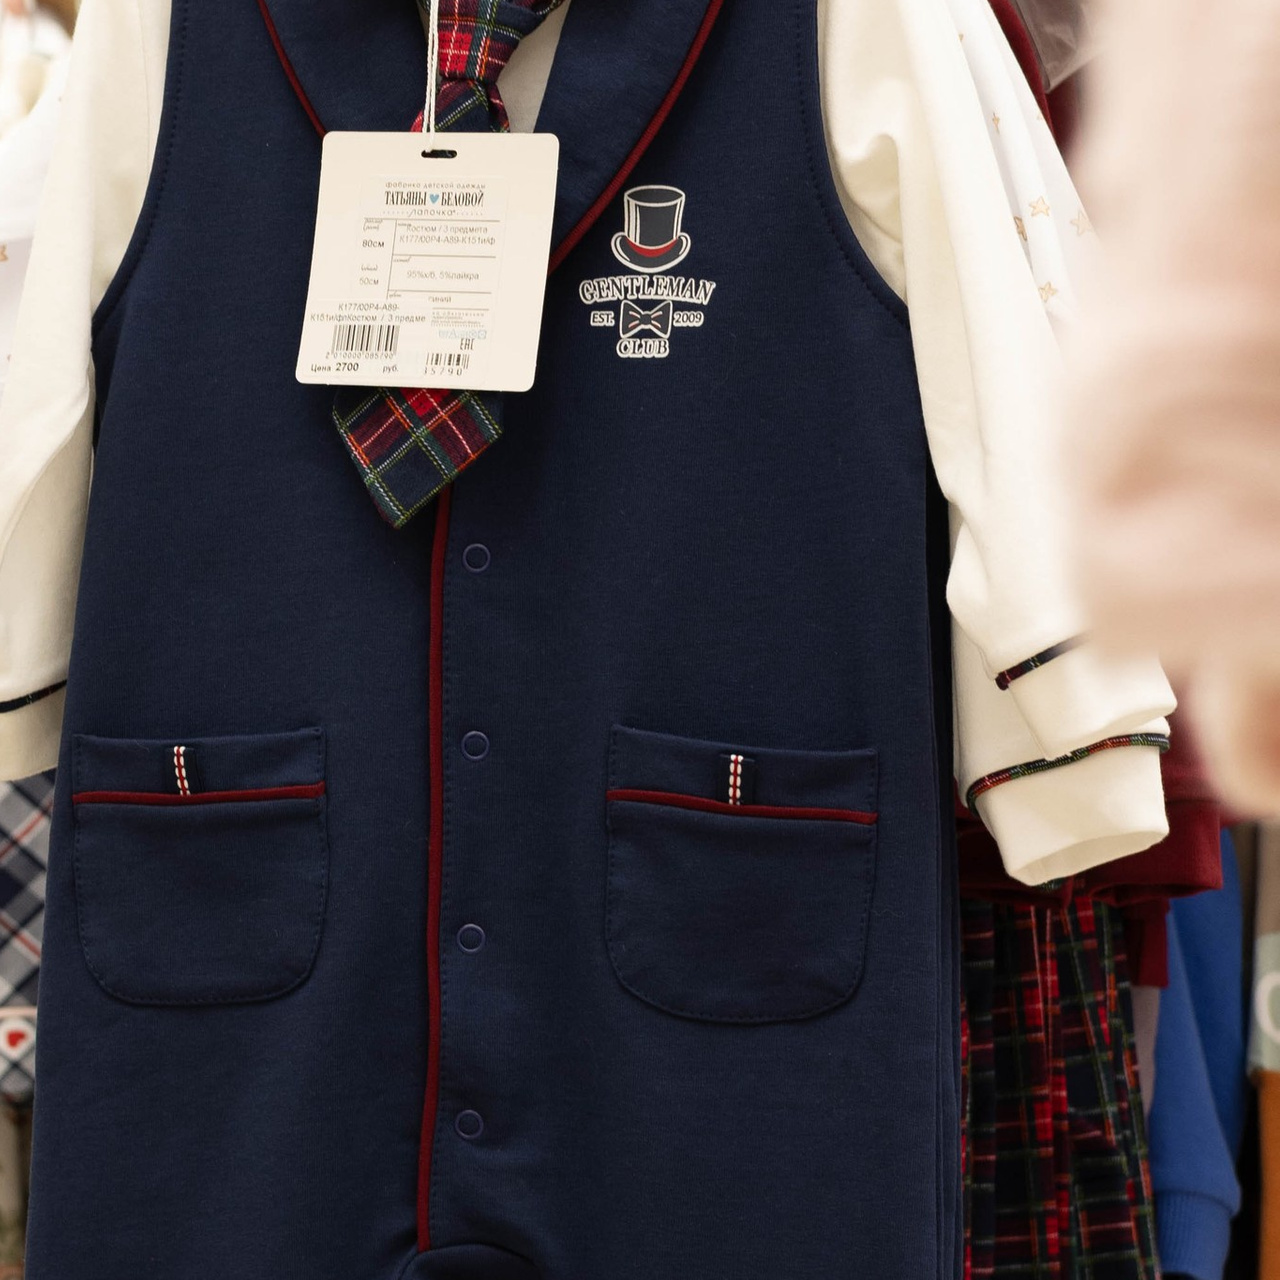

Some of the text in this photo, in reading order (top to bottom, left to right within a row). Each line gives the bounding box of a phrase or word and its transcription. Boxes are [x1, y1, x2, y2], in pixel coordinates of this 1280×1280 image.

[385, 190, 484, 207] ТАТЬЯНЫ БЕЛОВОЙ
[450, 226, 488, 234] предмета
[362, 239, 385, 248] 80см
[579, 275, 716, 305] GENTLEMAN
[590, 310, 704, 327] EST. 2009
[616, 338, 670, 358] CLUB
[310, 362, 399, 374] Цена 2700 руб.
